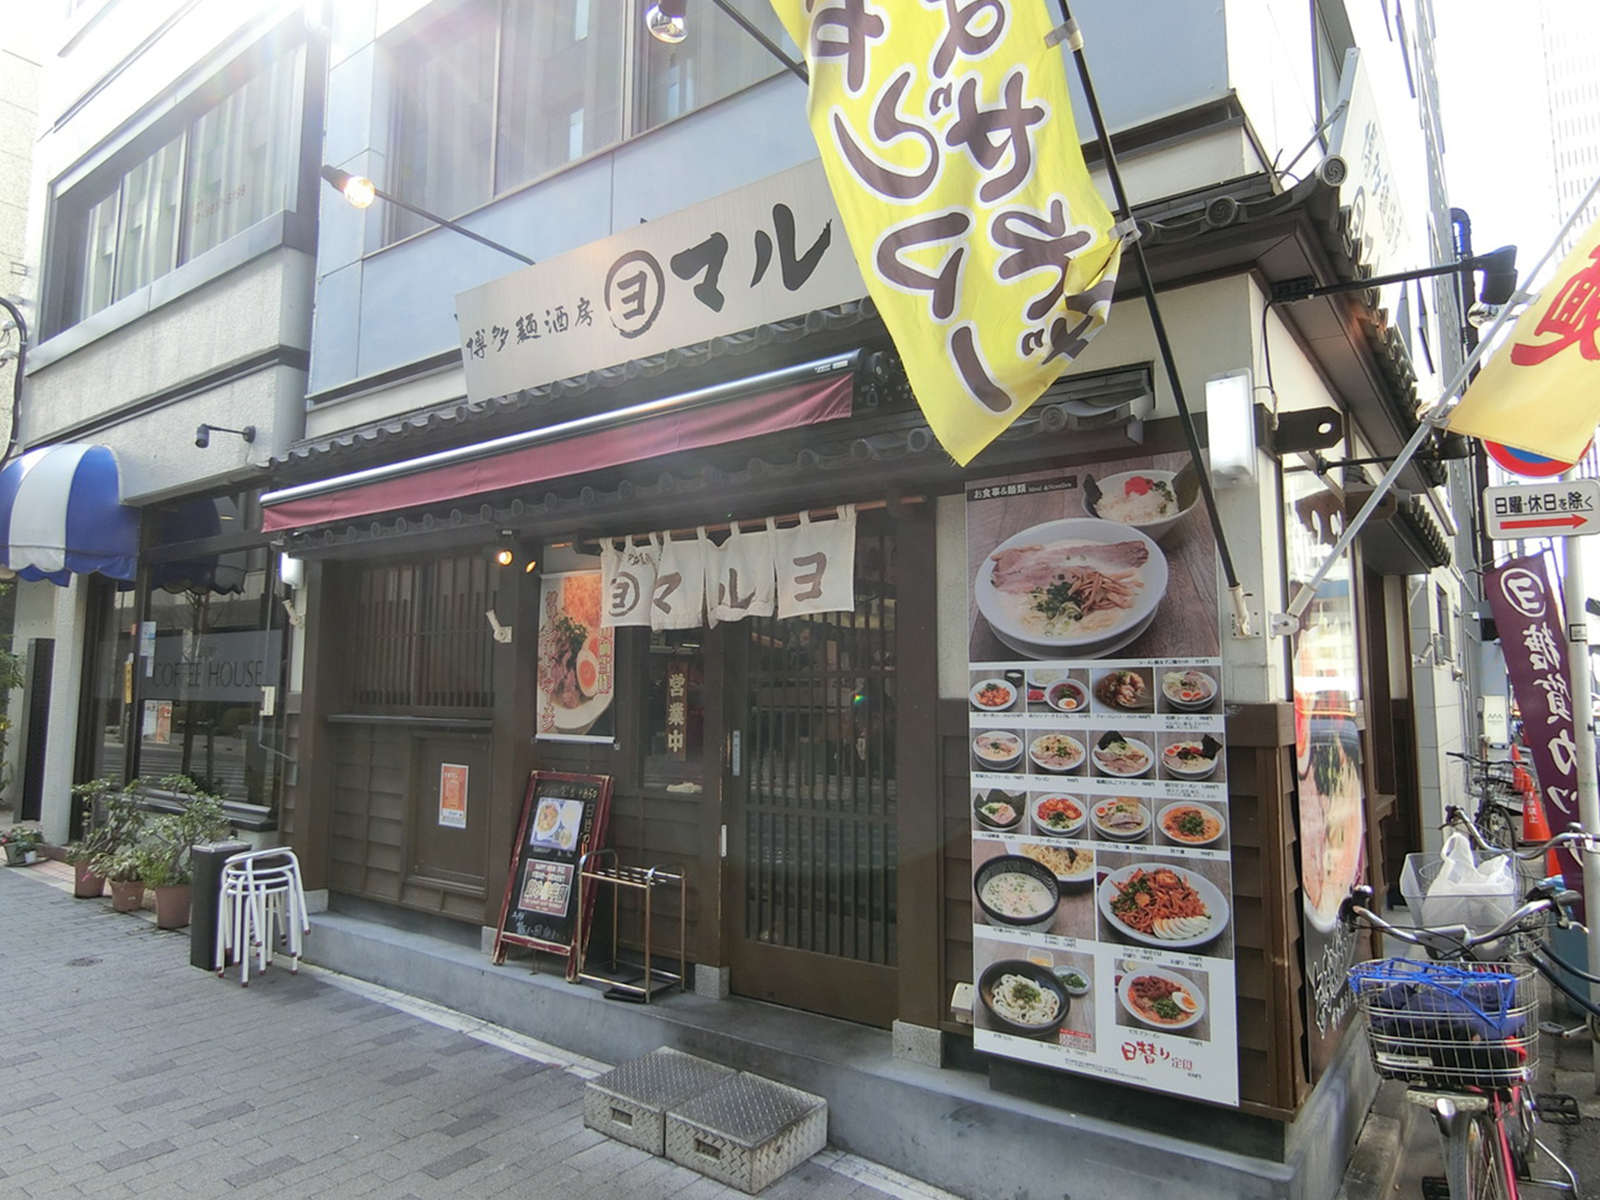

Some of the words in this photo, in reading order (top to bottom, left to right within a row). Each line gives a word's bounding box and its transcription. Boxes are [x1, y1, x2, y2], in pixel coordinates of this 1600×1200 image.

[466, 297, 594, 361] 博多麺酒房
[670, 204, 834, 313] マル
[1494, 491, 1594, 514] 日曜・休日を除く
[153, 662, 203, 688] COFFEE
[207, 660, 265, 687] HOUSE
[668, 673, 686, 753] 営業中
